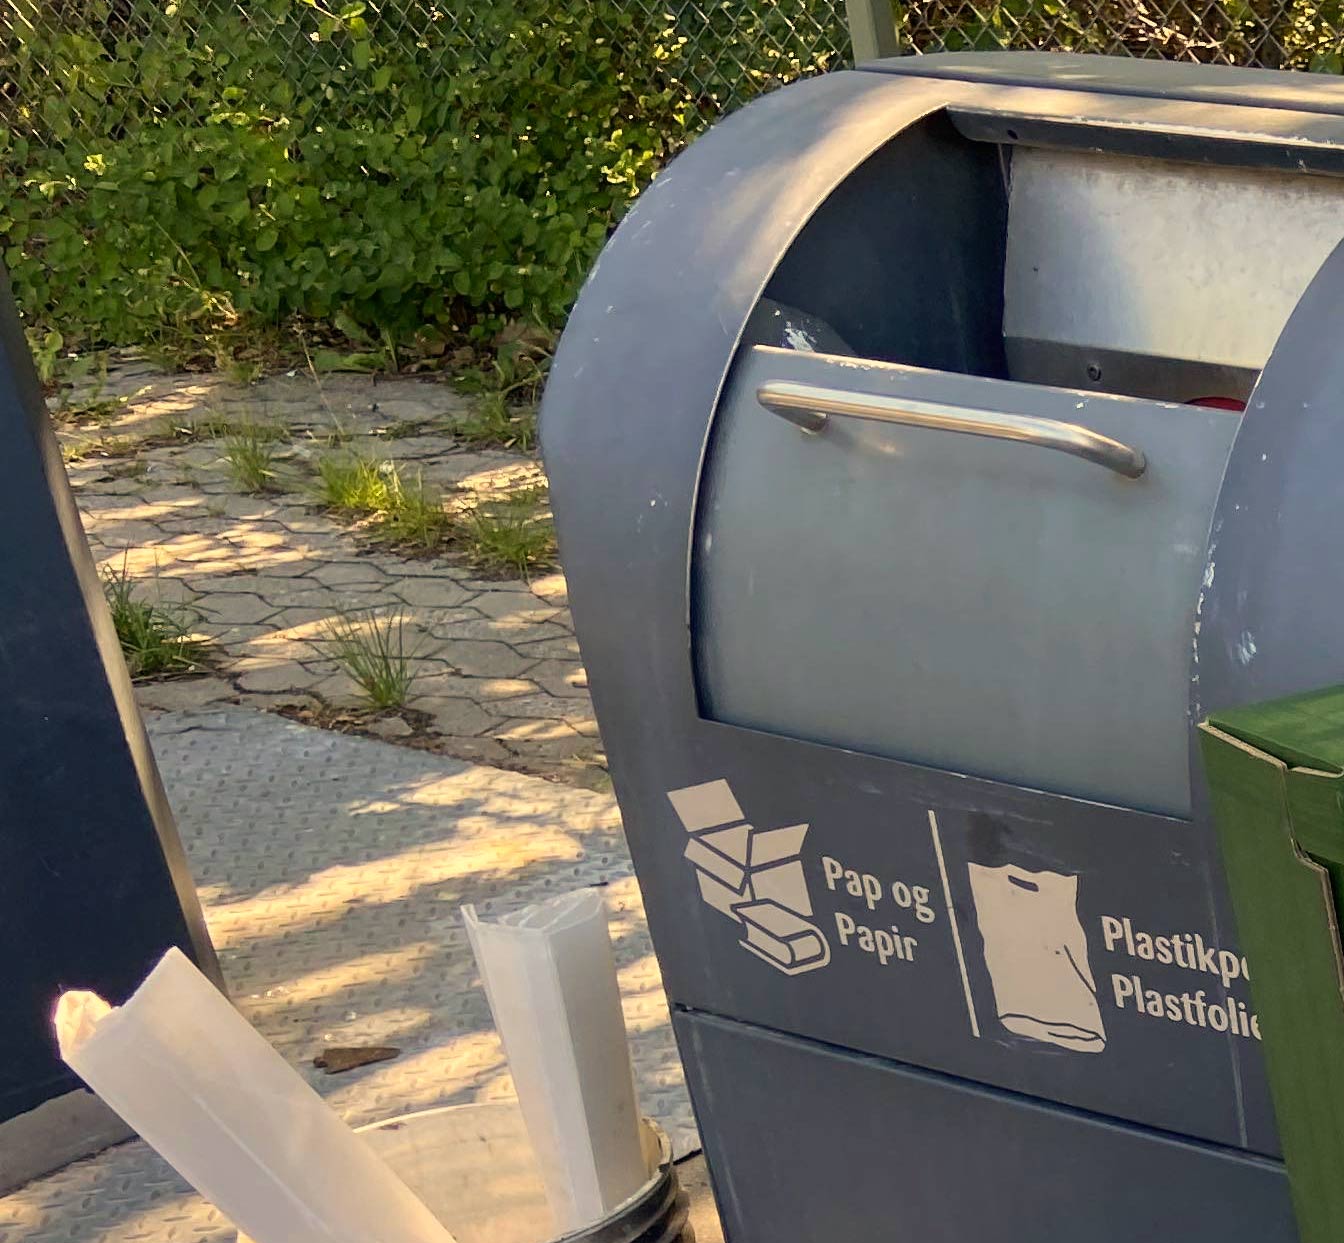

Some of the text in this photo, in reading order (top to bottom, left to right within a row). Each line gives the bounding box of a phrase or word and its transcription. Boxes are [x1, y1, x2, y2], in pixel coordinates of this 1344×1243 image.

[822, 856, 936, 924] Pap og
[834, 912, 918, 965] Papir
